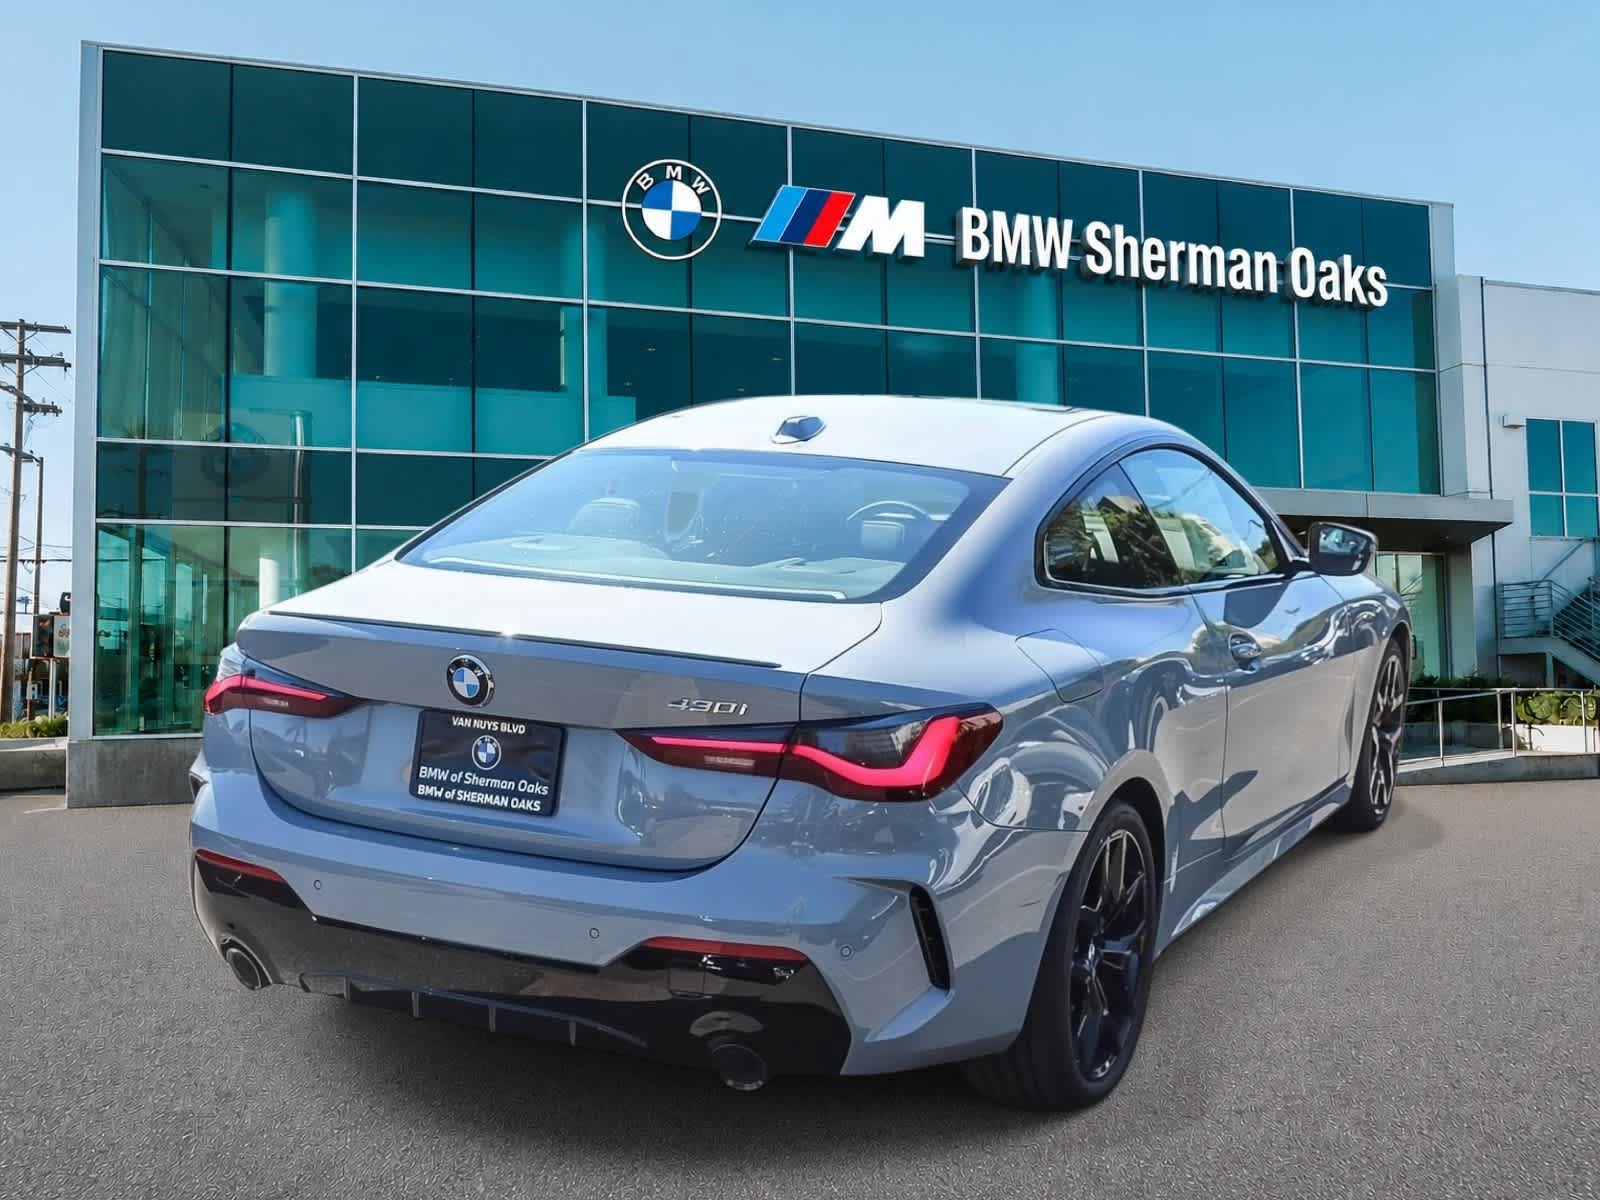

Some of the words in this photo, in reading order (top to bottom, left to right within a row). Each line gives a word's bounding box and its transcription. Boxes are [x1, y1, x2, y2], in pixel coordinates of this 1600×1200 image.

[636, 165, 711, 195] BMW
[960, 206, 1073, 270] BMW
[1084, 220, 1279, 294] Sherman
[1289, 246, 1389, 307] Oaks
[451, 716, 471, 727] VAN
[473, 719, 499, 731] NUYS
[500, 723, 526, 734] BLVD
[418, 766, 449, 781] BMW
[450, 771, 463, 783] of
[463, 772, 515, 791] Sherman
[518, 780, 549, 796] Oaks
[417, 784, 443, 797] BMW
[444, 788, 456, 800] of
[456, 790, 509, 807] SHERMAN
[510, 798, 541, 811] OAKS
